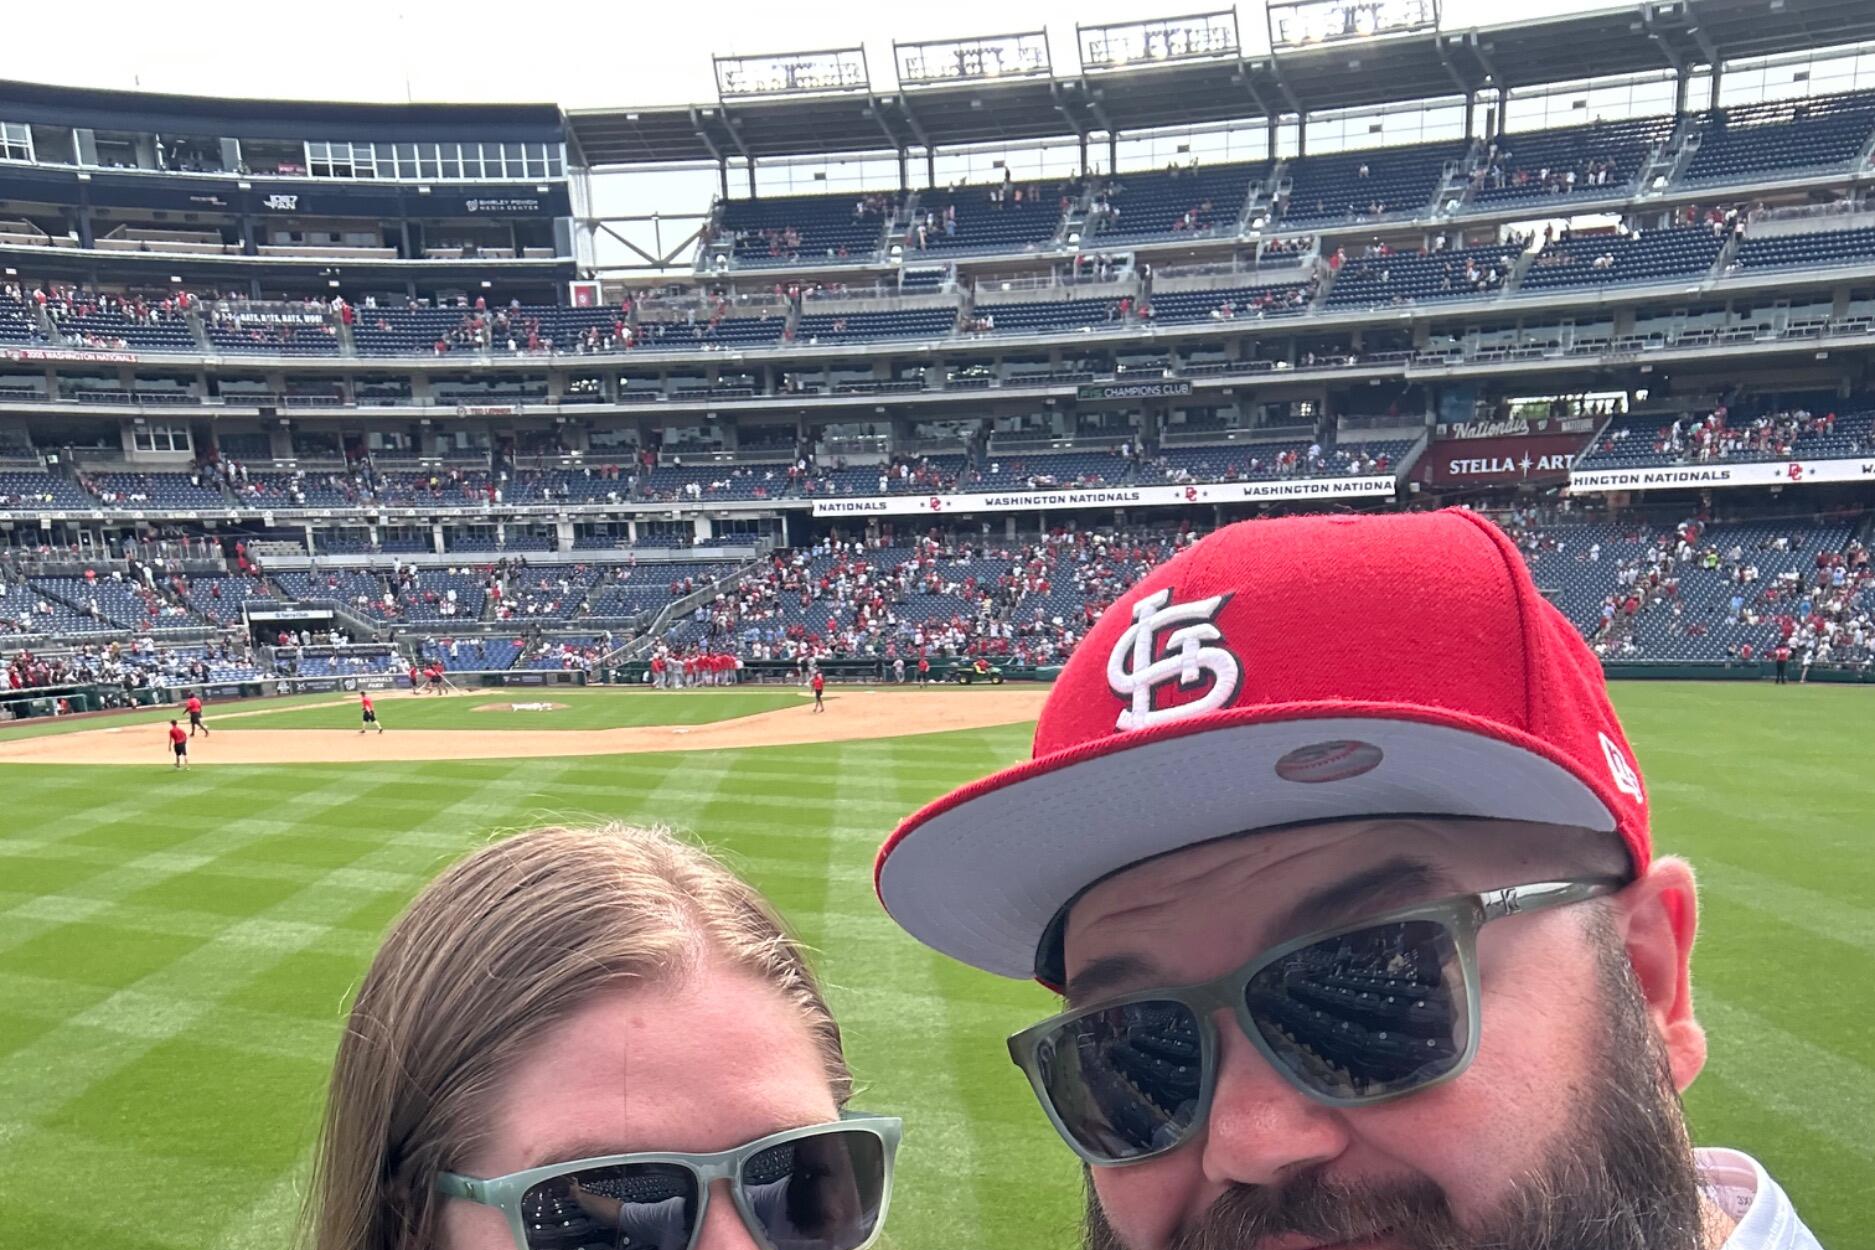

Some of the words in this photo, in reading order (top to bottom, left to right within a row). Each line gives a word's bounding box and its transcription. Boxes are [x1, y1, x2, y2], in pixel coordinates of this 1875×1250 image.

[46, 351, 95, 361] WASHINGTON
[96, 352, 136, 363] NATIONALS
[1104, 386, 1161, 397] CHAMPIONS
[1163, 384, 1189, 394] CLUB
[1453, 419, 1529, 439] Nationals
[1449, 457, 1515, 475] STELLA
[1574, 474, 1640, 486] HINGTON
[1644, 470, 1731, 483] NATIONALS
[1243, 484, 1329, 496] WASHINGTON
[1333, 481, 1395, 492] NATIONA
[985, 495, 1065, 505] WASHINGTON
[1070, 492, 1139, 503] NATIONALS
[819, 502, 887, 511] NATIONALS
